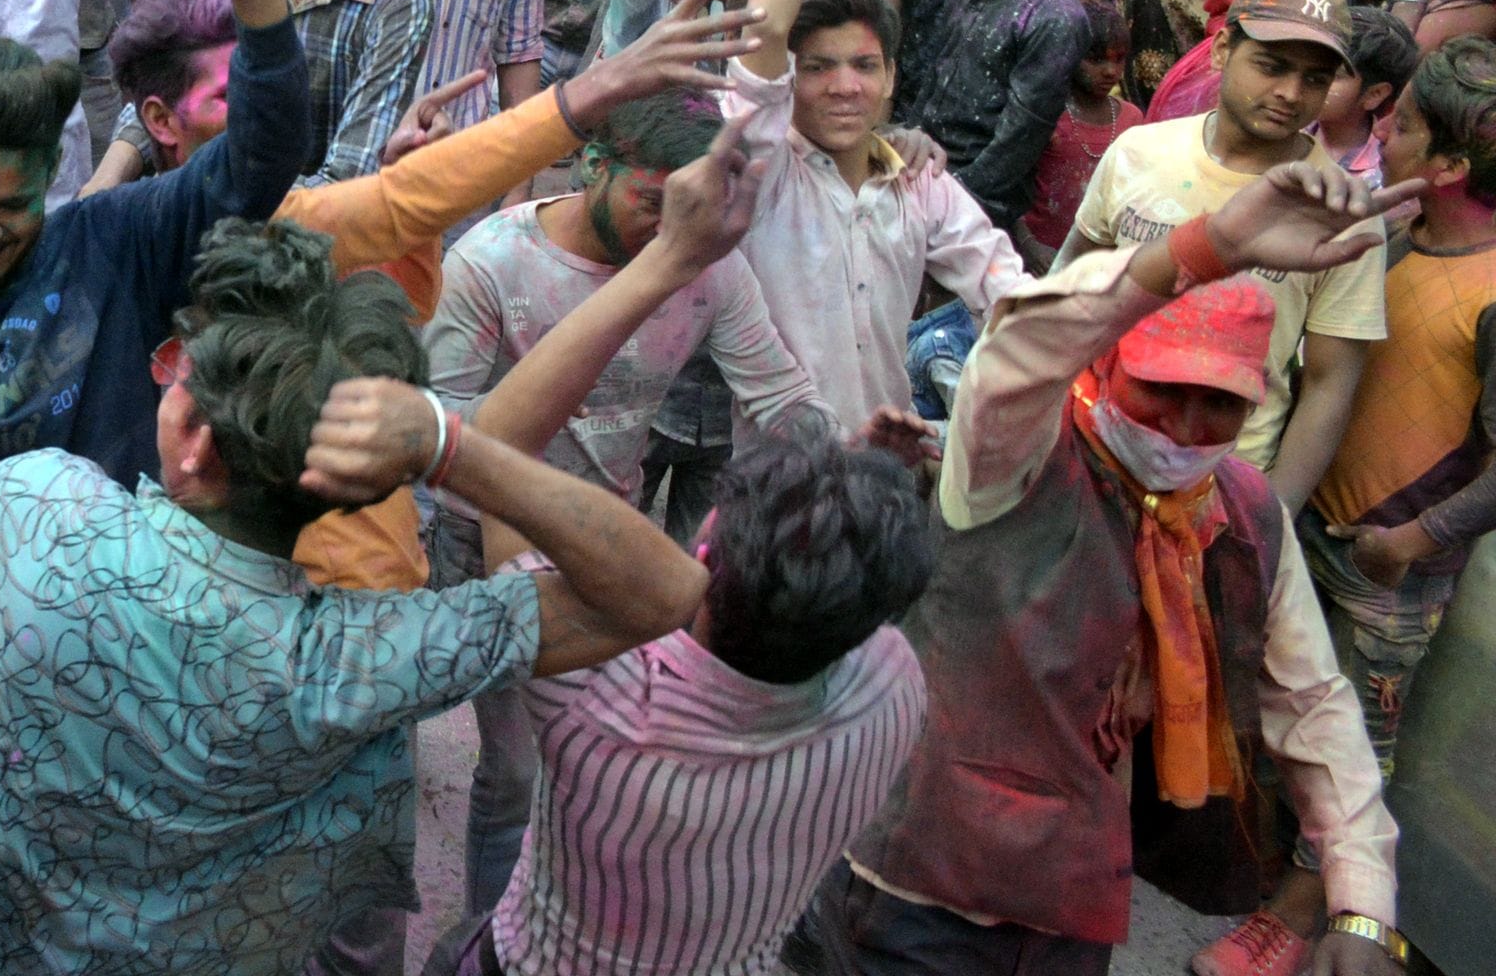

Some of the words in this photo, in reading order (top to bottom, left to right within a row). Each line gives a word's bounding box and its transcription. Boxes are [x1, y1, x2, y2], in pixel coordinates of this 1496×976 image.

[508, 297, 529, 307] VIN
[509, 310, 525, 319] TA
[511, 321, 528, 331] GE
